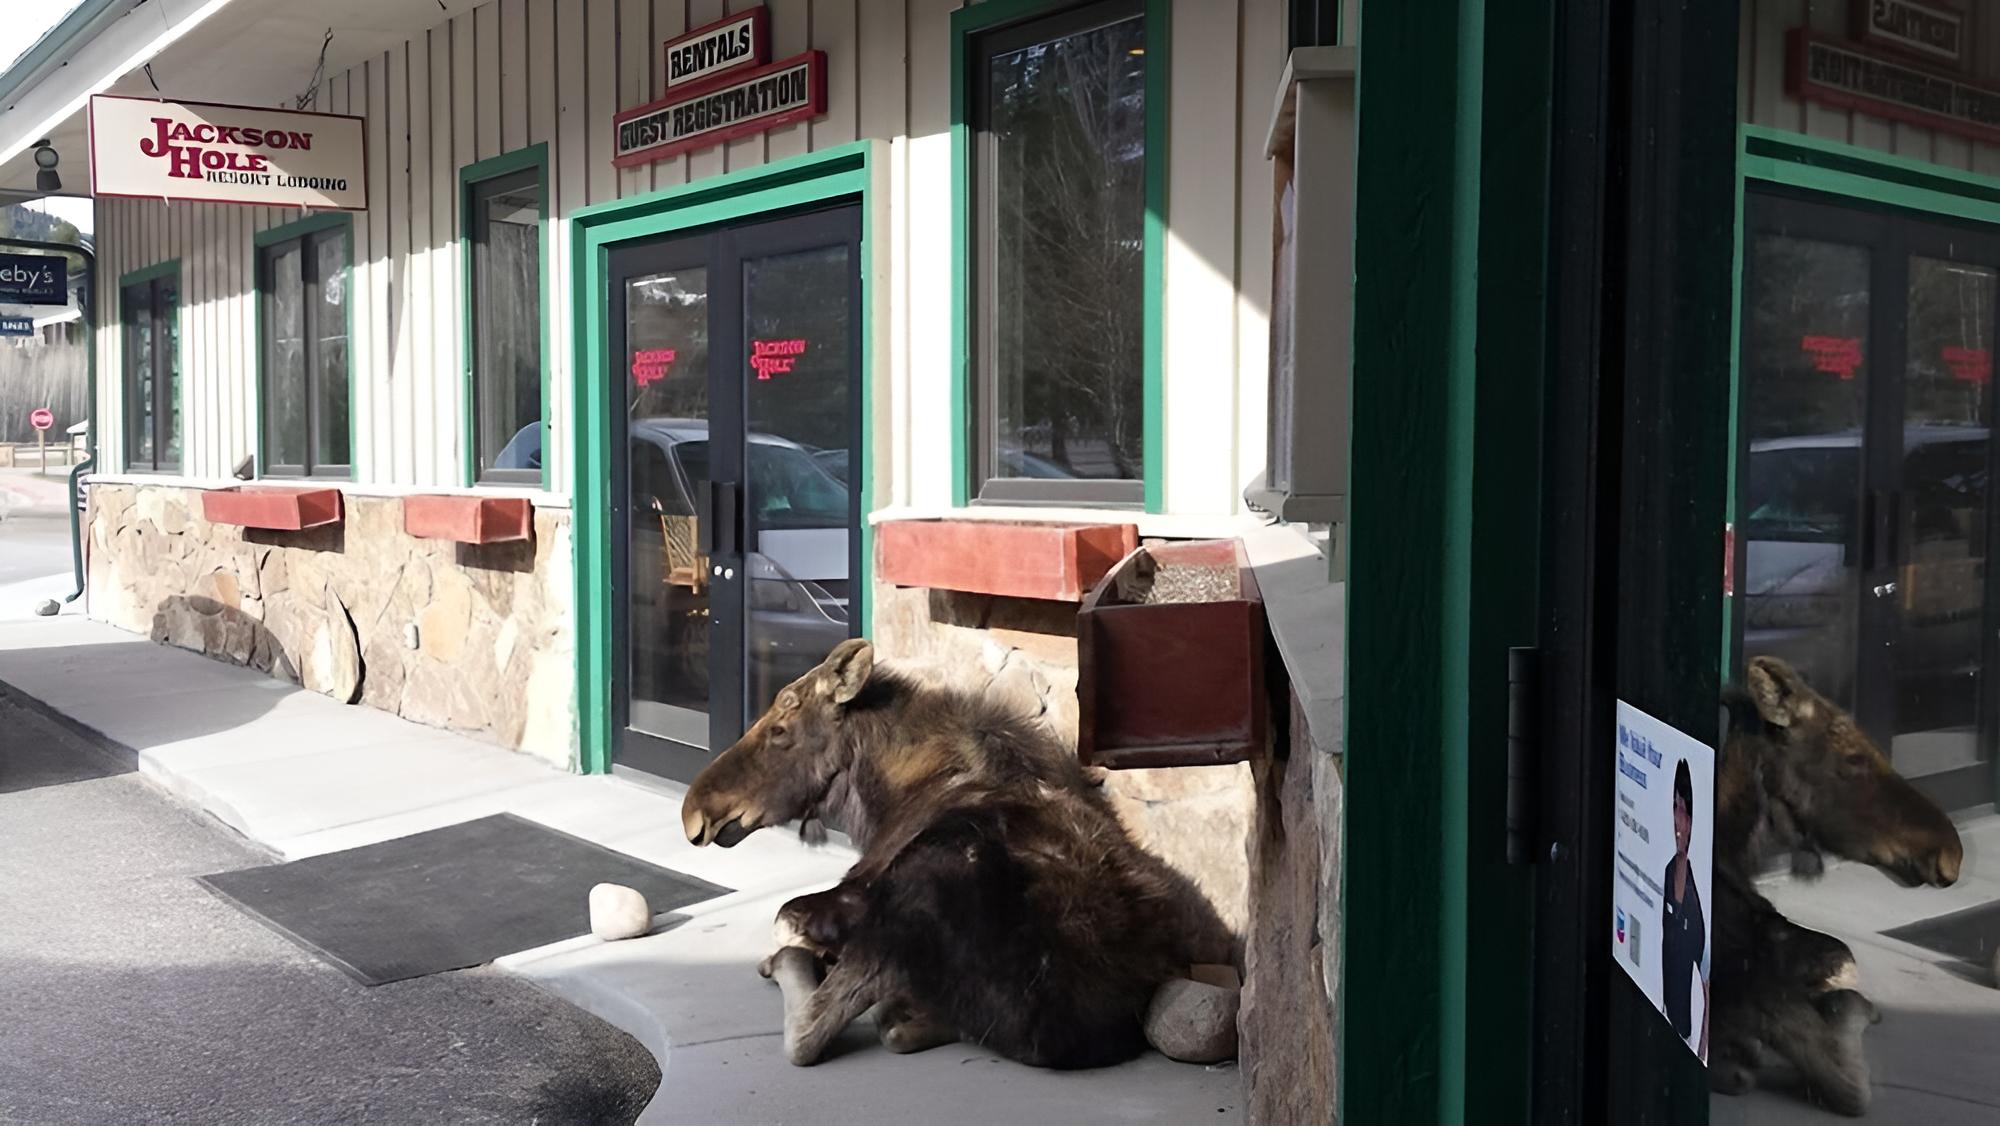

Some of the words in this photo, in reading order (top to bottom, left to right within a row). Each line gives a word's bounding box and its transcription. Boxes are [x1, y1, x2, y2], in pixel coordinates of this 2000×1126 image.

[670, 24, 750, 81] RENTALS
[619, 110, 669, 151] GUEST
[672, 67, 806, 137] REGISTRATION
[140, 117, 313, 157] JACKSON
[168, 146, 268, 179] HOLE
